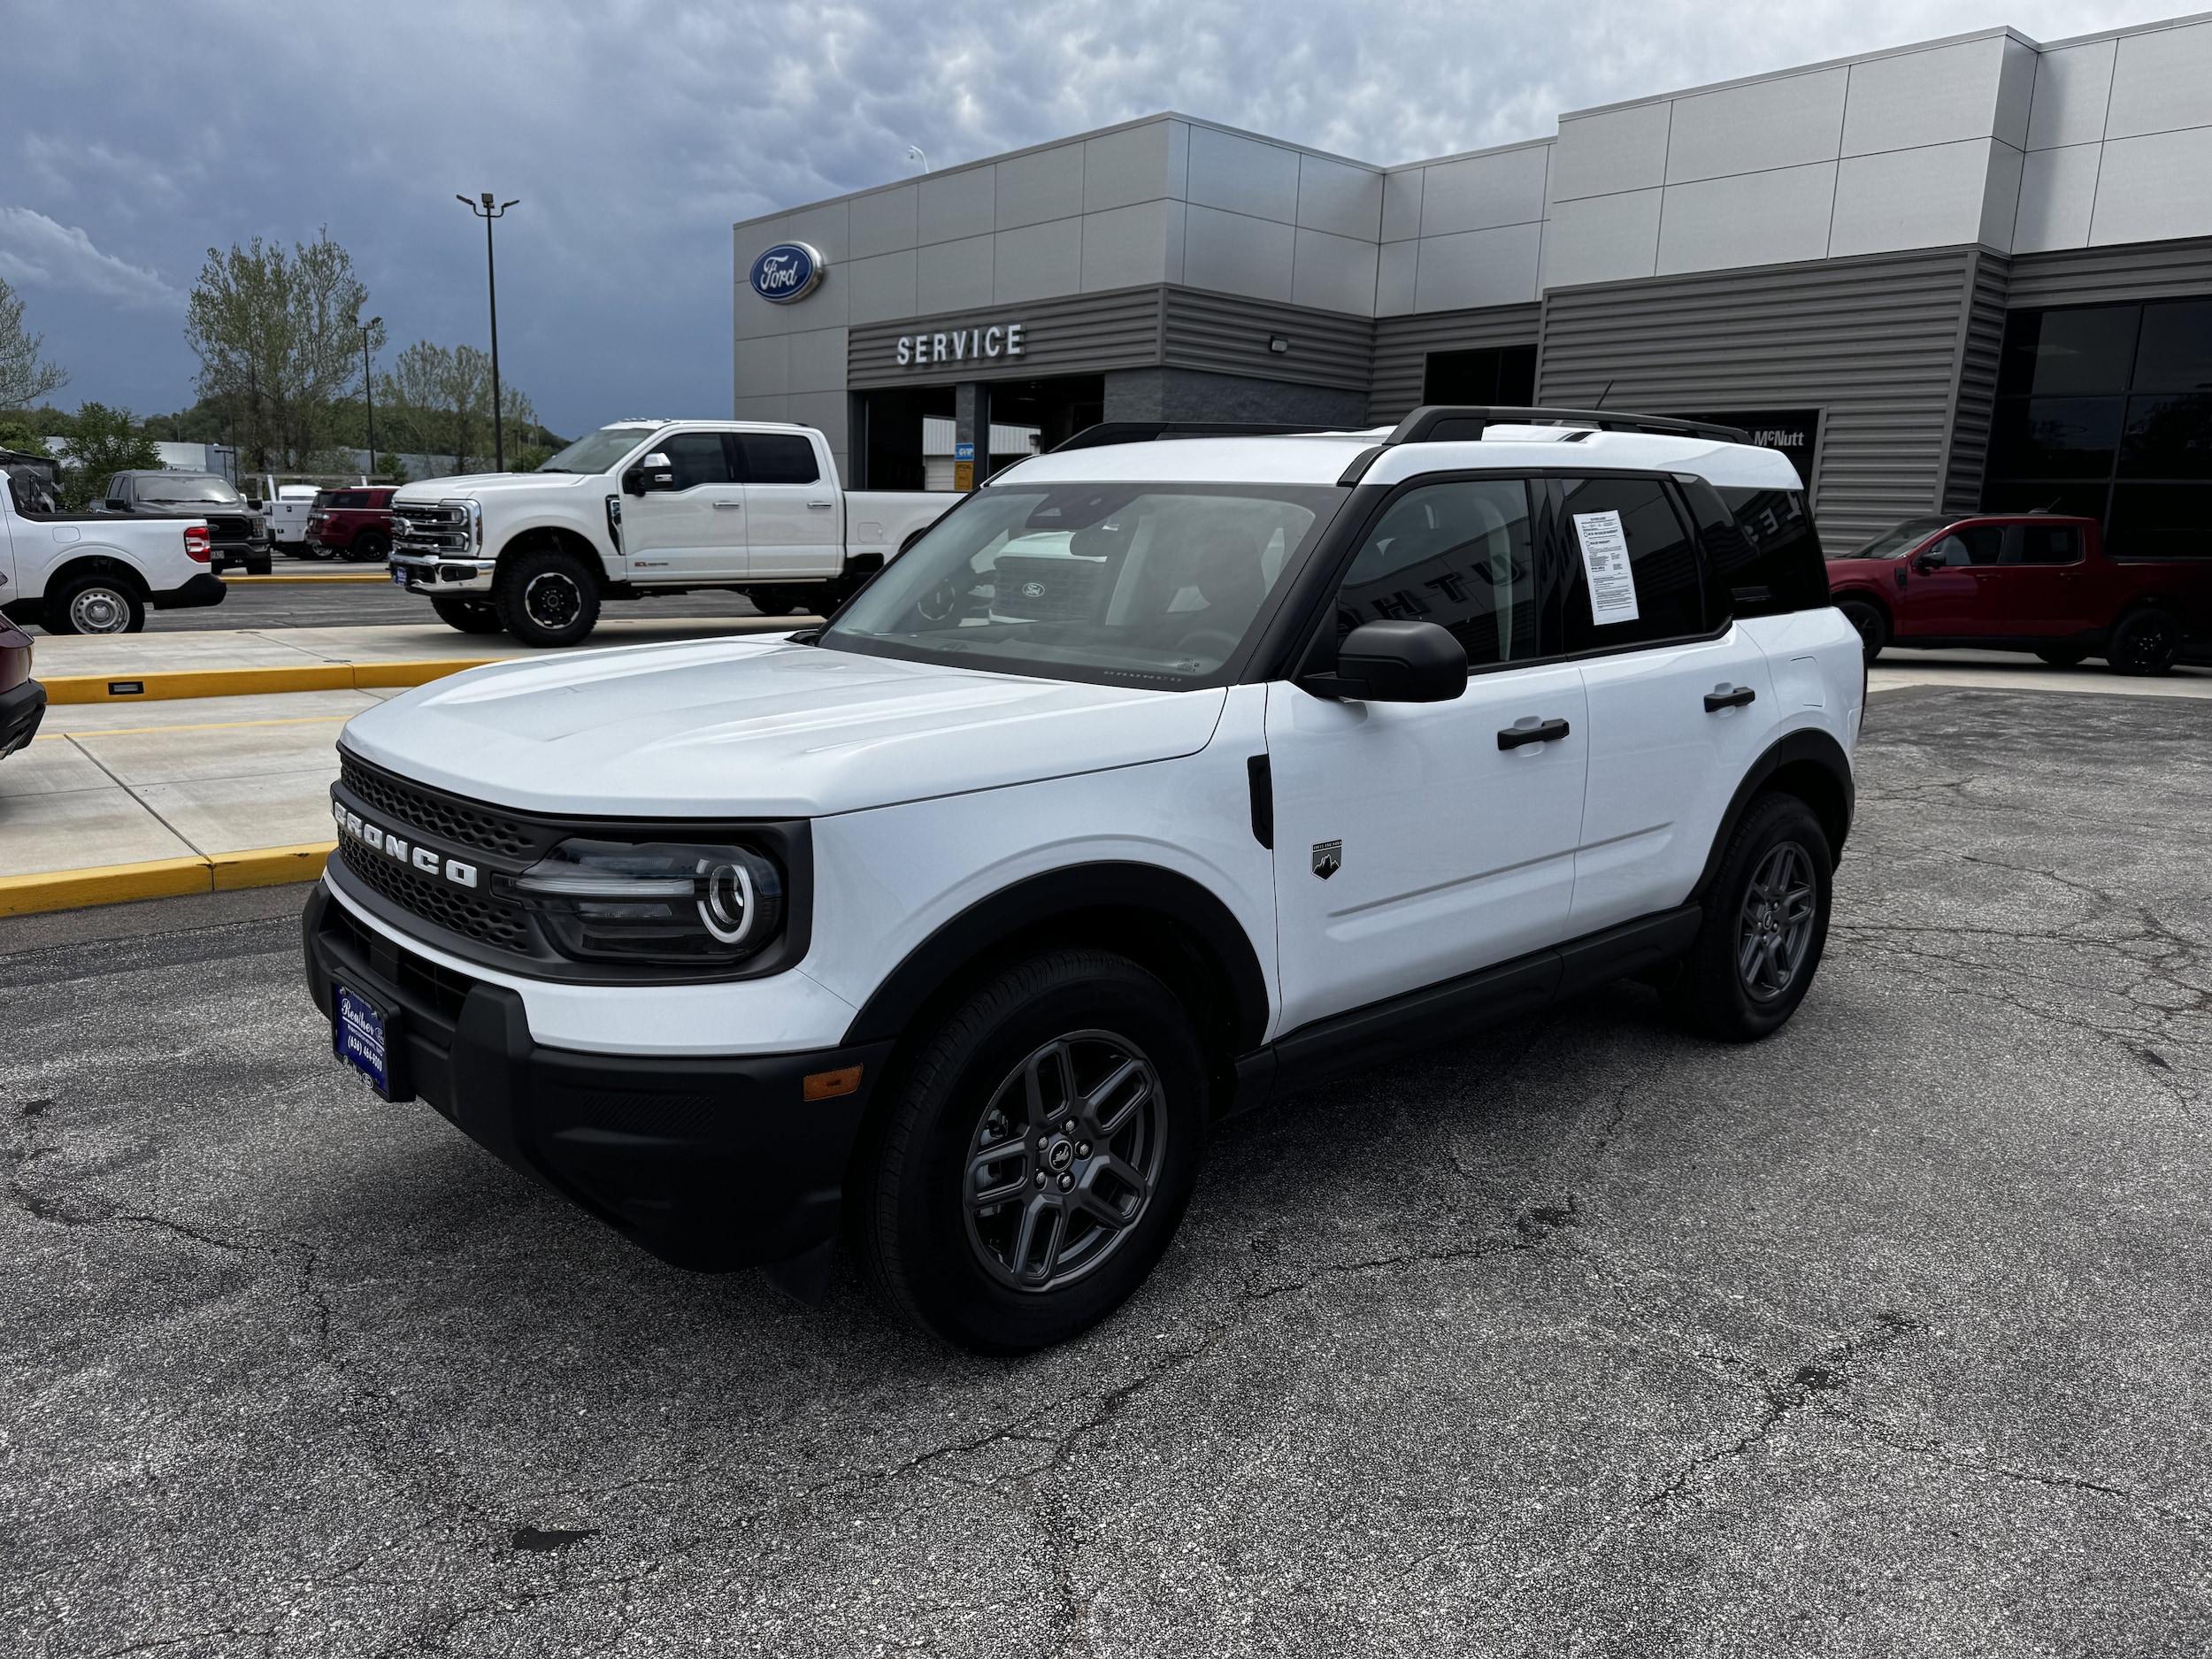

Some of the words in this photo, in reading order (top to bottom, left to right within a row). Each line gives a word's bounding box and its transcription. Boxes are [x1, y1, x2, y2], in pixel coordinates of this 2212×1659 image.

[760, 255, 798, 291] Ford
[896, 324, 1023, 365] SERVICE
[1754, 430, 1805, 447] McNutt
[1103, 670, 1182, 682] BRONCO
[334, 801, 478, 889] BRONCO
